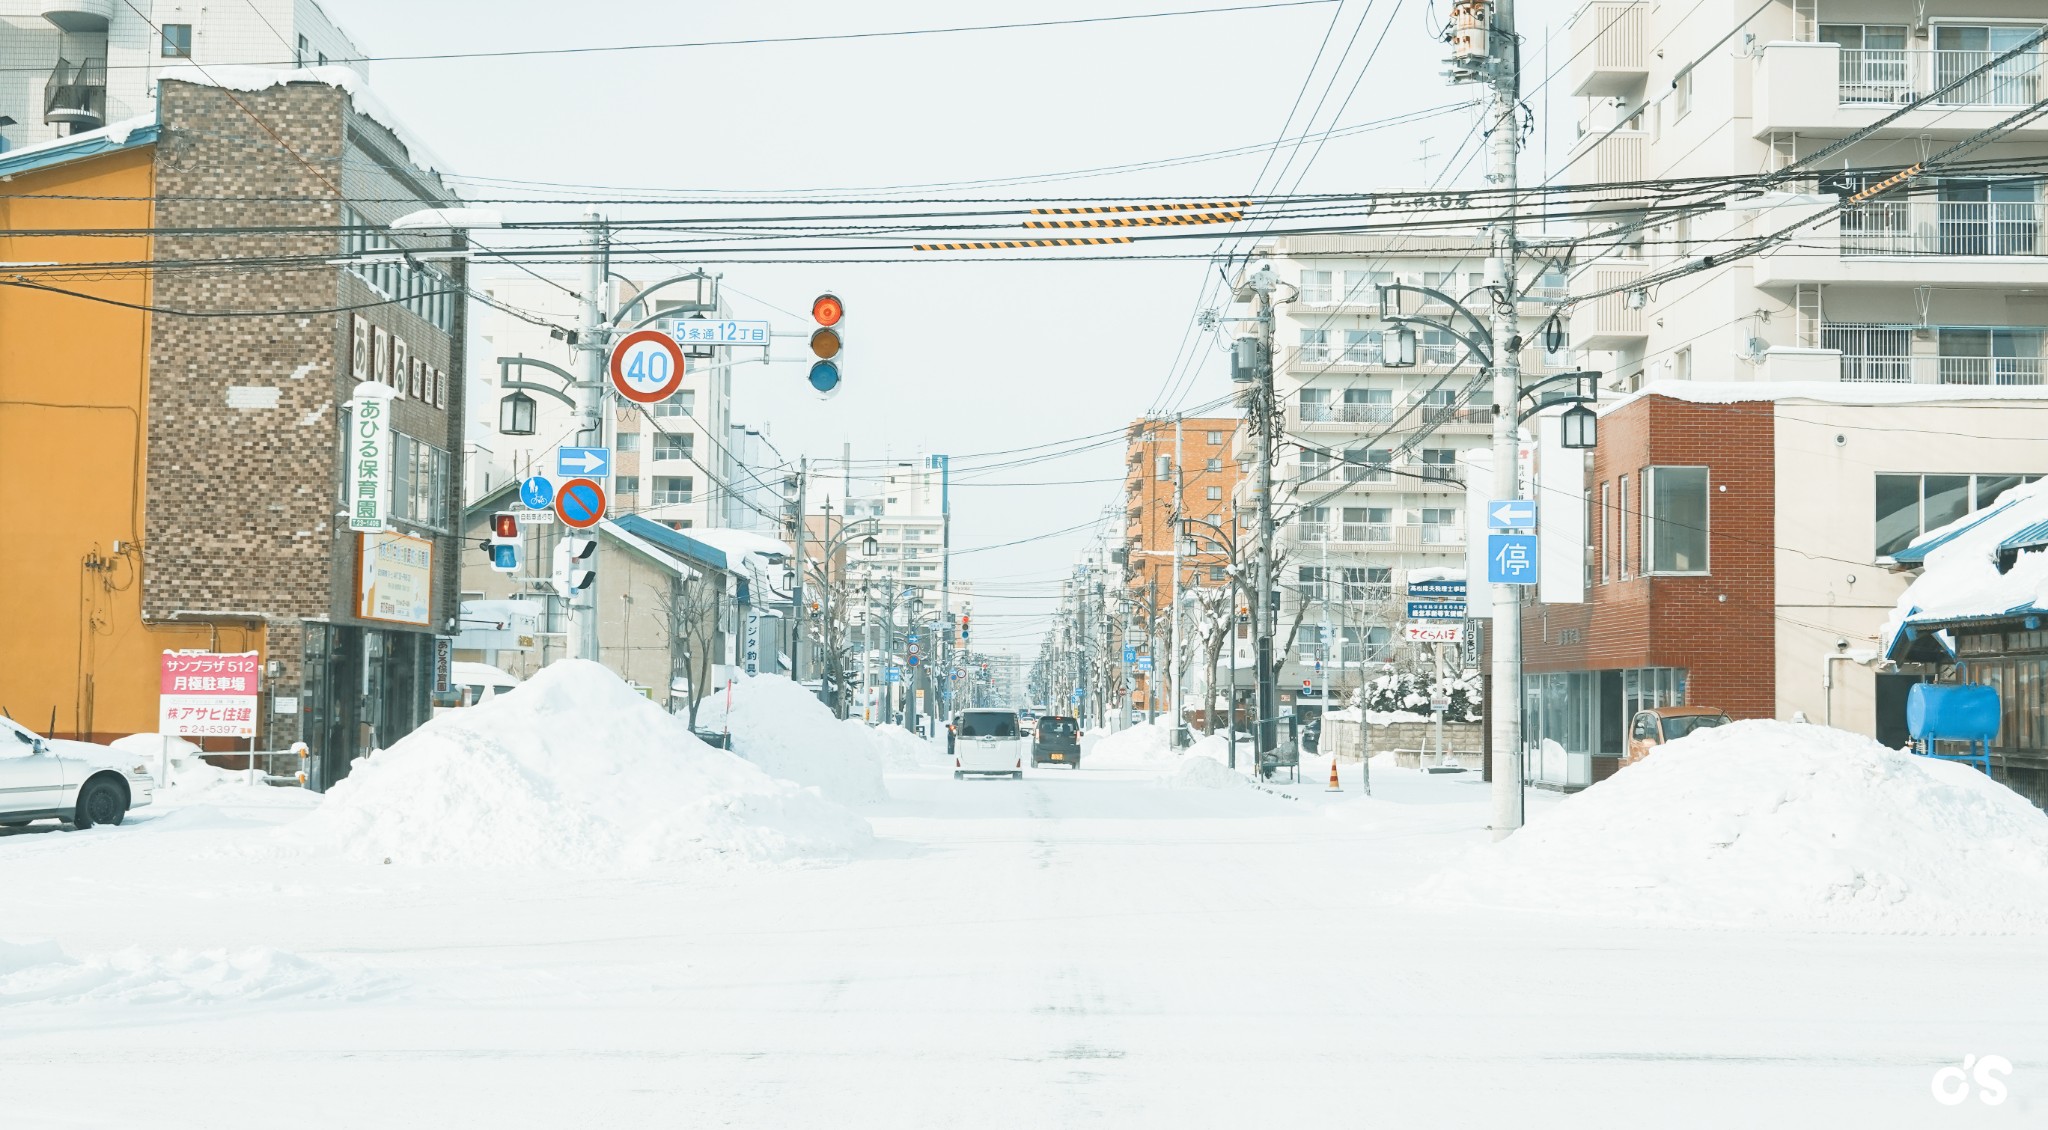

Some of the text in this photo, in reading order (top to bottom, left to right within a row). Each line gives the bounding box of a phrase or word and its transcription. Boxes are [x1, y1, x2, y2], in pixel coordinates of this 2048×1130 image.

[676, 322, 764, 341] 5条通12丁目
[355, 321, 445, 406] あひる保育園
[627, 351, 668, 383] 40
[357, 400, 379, 518] あひる保育園
[1495, 543, 1530, 576] 停
[747, 615, 758, 673] フジタ釣具
[1409, 628, 1458, 640] さくらんぼ
[227, 661, 255, 673] 512
[437, 640, 448, 692] あひる保育園
[173, 676, 246, 692] 月極駐車場
[191, 725, 237, 734] 24-5397
